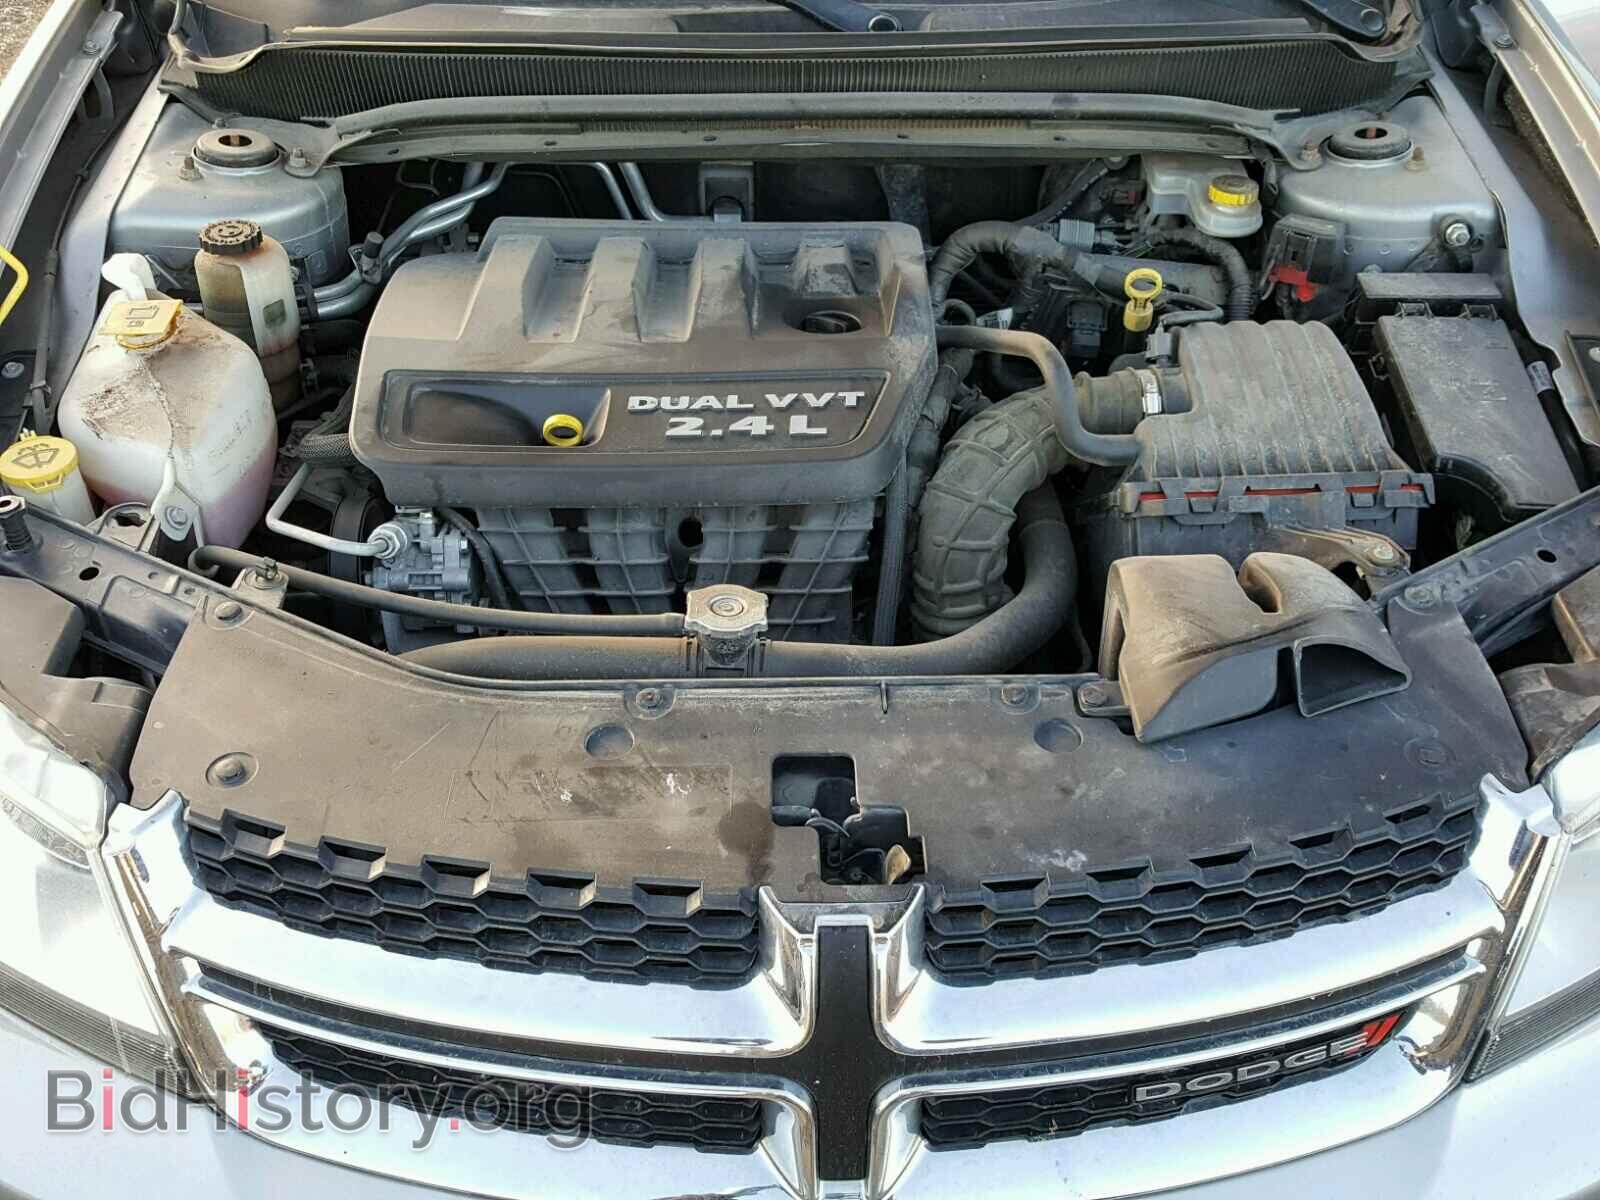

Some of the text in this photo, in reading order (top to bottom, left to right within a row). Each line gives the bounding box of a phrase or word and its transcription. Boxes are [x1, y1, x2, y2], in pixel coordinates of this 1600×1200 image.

[627, 391, 865, 412] DUAL VVT
[665, 415, 774, 440] 2.4
[1135, 1032, 1368, 1101] DODGE
